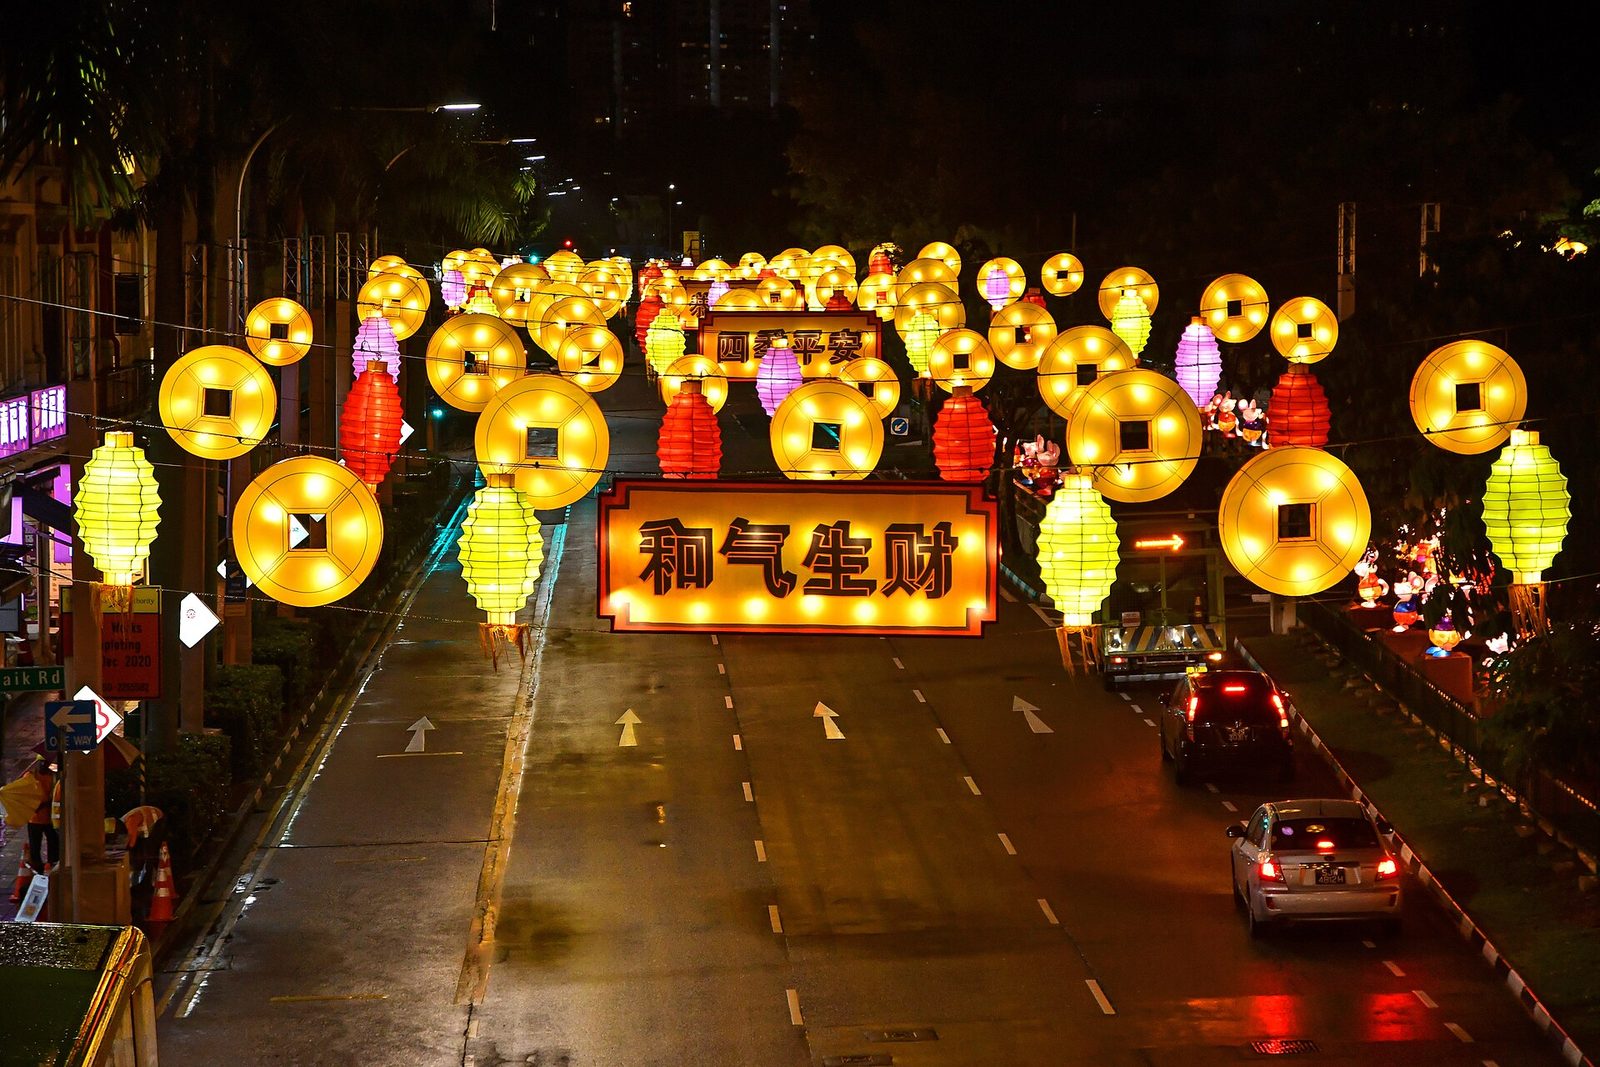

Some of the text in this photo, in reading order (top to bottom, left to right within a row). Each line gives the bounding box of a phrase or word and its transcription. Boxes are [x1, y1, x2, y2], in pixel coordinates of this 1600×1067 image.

[639, 517, 959, 598] 和气生财
[104, 640, 141, 653] pleting
[124, 655, 152, 667] 2020
[3, 670, 60, 686] aik Rd
[49, 735, 93, 747] OE WAY
